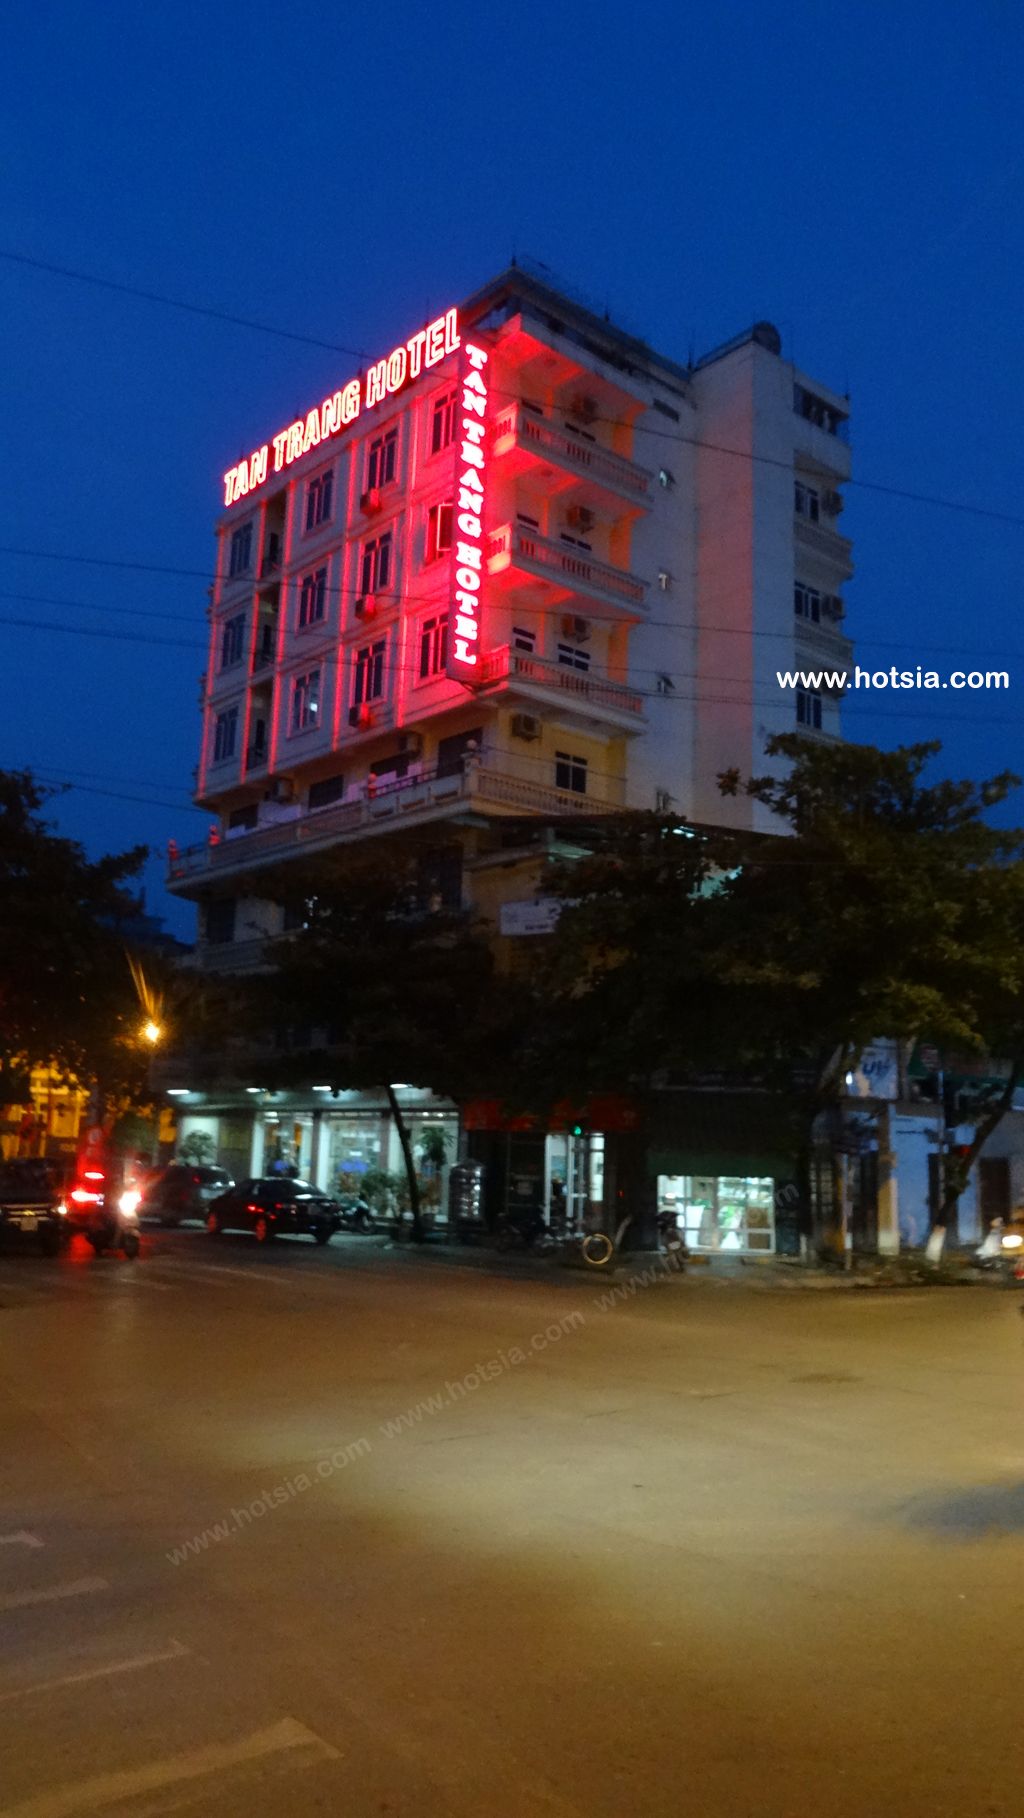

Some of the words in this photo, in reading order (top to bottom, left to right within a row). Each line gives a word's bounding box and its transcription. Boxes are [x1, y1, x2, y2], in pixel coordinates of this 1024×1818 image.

[224, 445, 269, 506] TAN
[273, 379, 361, 473] TRANG
[366, 307, 461, 410] HOTEL
[463, 344, 488, 417] TAN
[457, 418, 485, 538] TRANG
[453, 540, 482, 665] HOTEL
